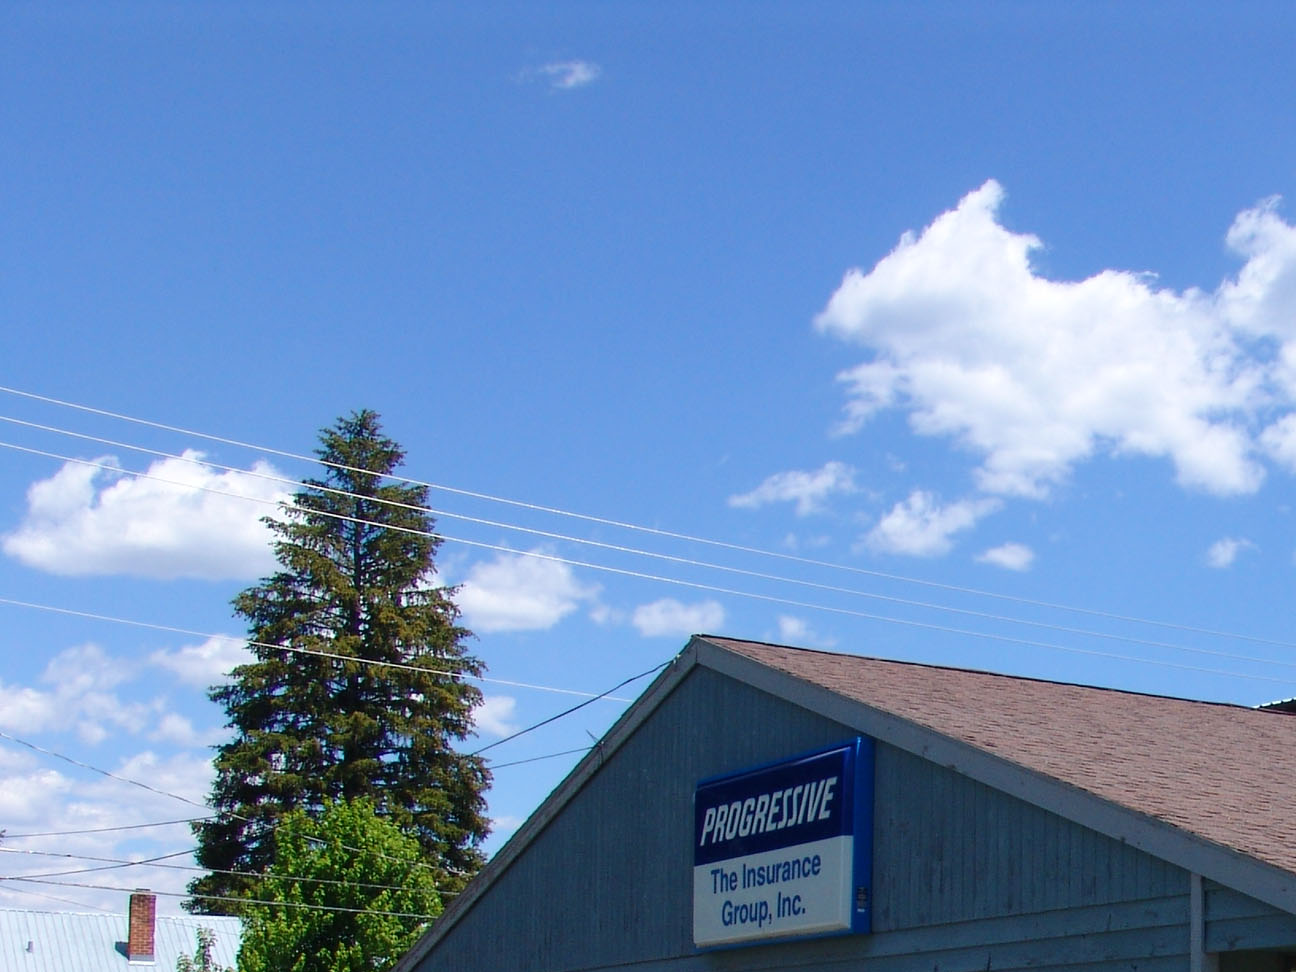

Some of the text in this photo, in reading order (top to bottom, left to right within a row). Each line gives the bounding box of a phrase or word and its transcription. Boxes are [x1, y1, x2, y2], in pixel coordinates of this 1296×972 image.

[700, 776, 838, 846] PROGRESSIVE
[711, 854, 822, 894] The Insurance
[722, 891, 806, 928] Group, Inc.
